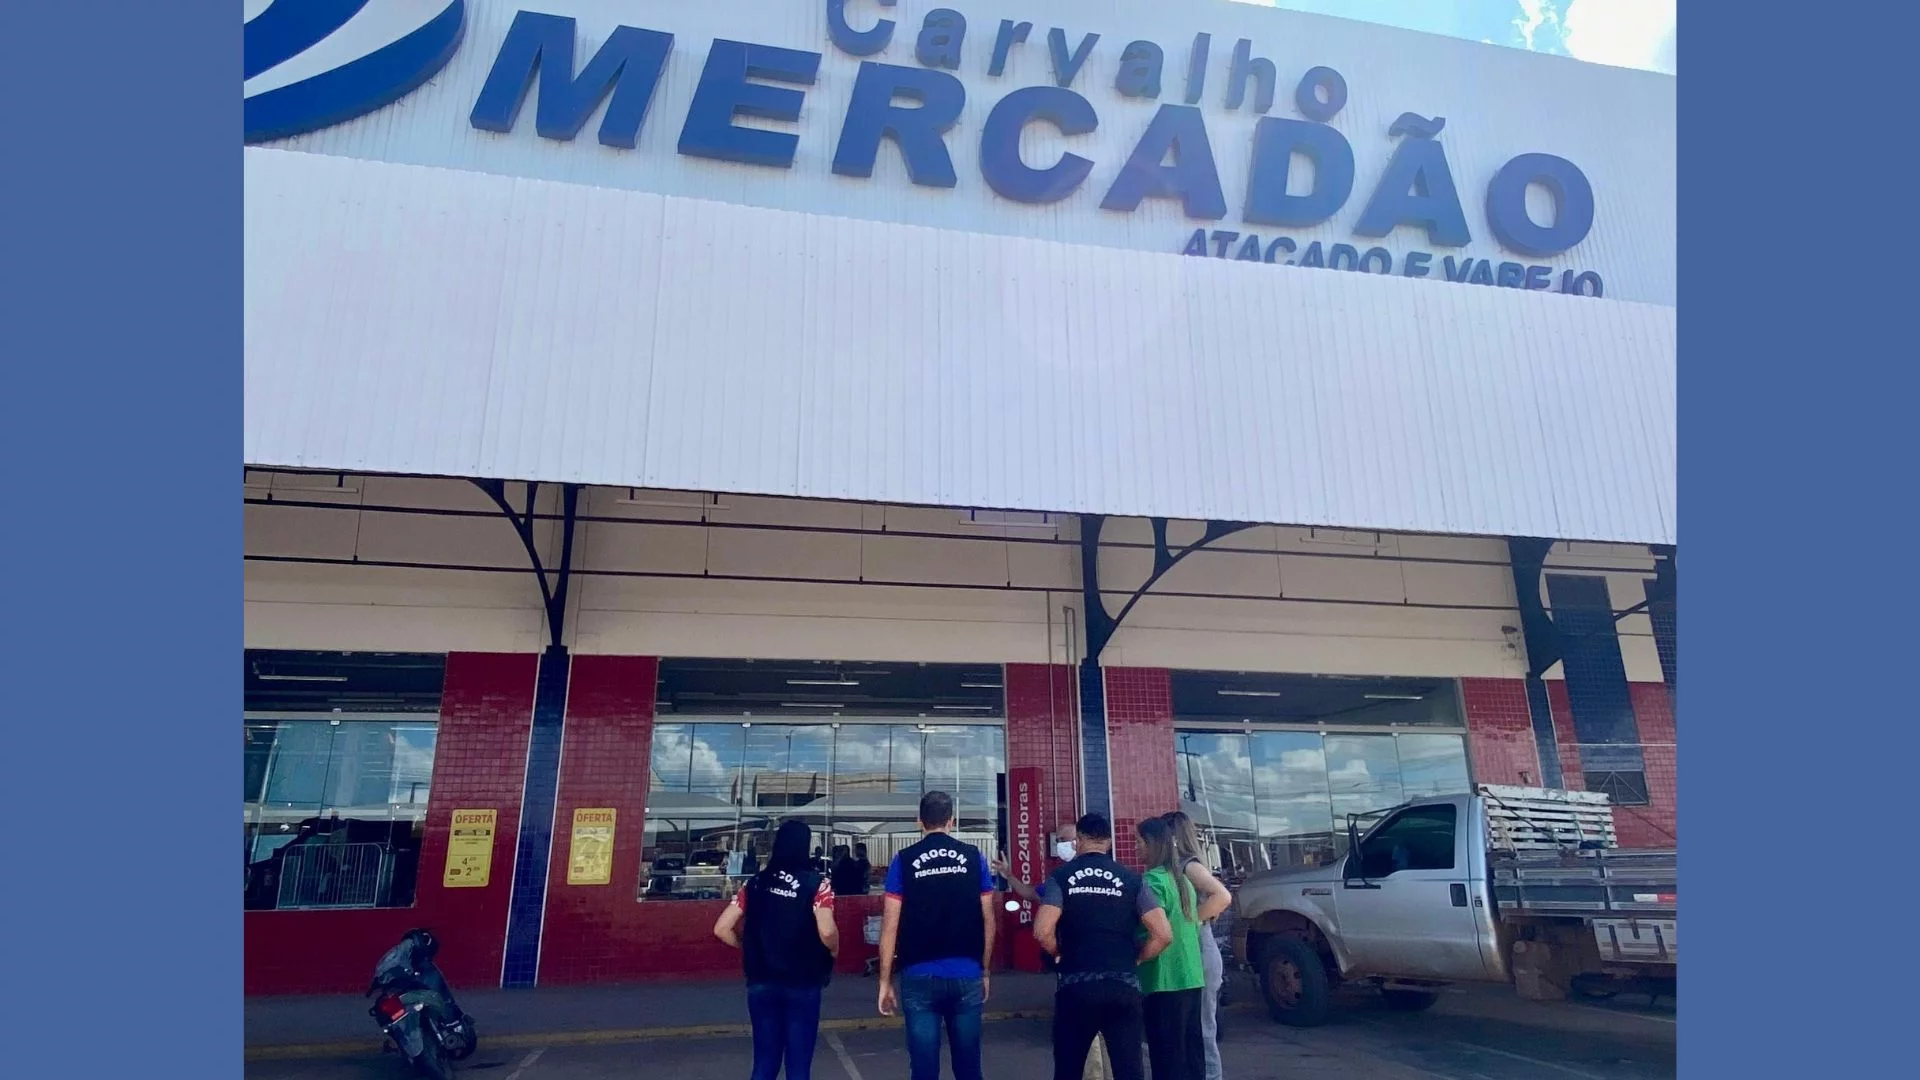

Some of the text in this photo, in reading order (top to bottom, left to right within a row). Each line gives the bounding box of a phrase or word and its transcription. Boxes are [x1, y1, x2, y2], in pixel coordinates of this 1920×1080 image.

[826, 0, 1348, 122] Carvalho
[470, 10, 1595, 258] MERCADÃO
[1182, 228, 1393, 275] ATACADO
[455, 814, 493, 824] OFERTA
[576, 813, 612, 823] OFERTA
[912, 848, 967, 869] PROCON
[1018, 782, 1032, 924] Baco24Horas
[778, 870, 800, 890] CON
[914, 865, 967, 878] FISCALIZAÇÃO
[1068, 867, 1124, 888] PROCON
[769, 887, 797, 898] LIZAÇÃO
[1068, 886, 1122, 897] FISCALIZAÇÃO
